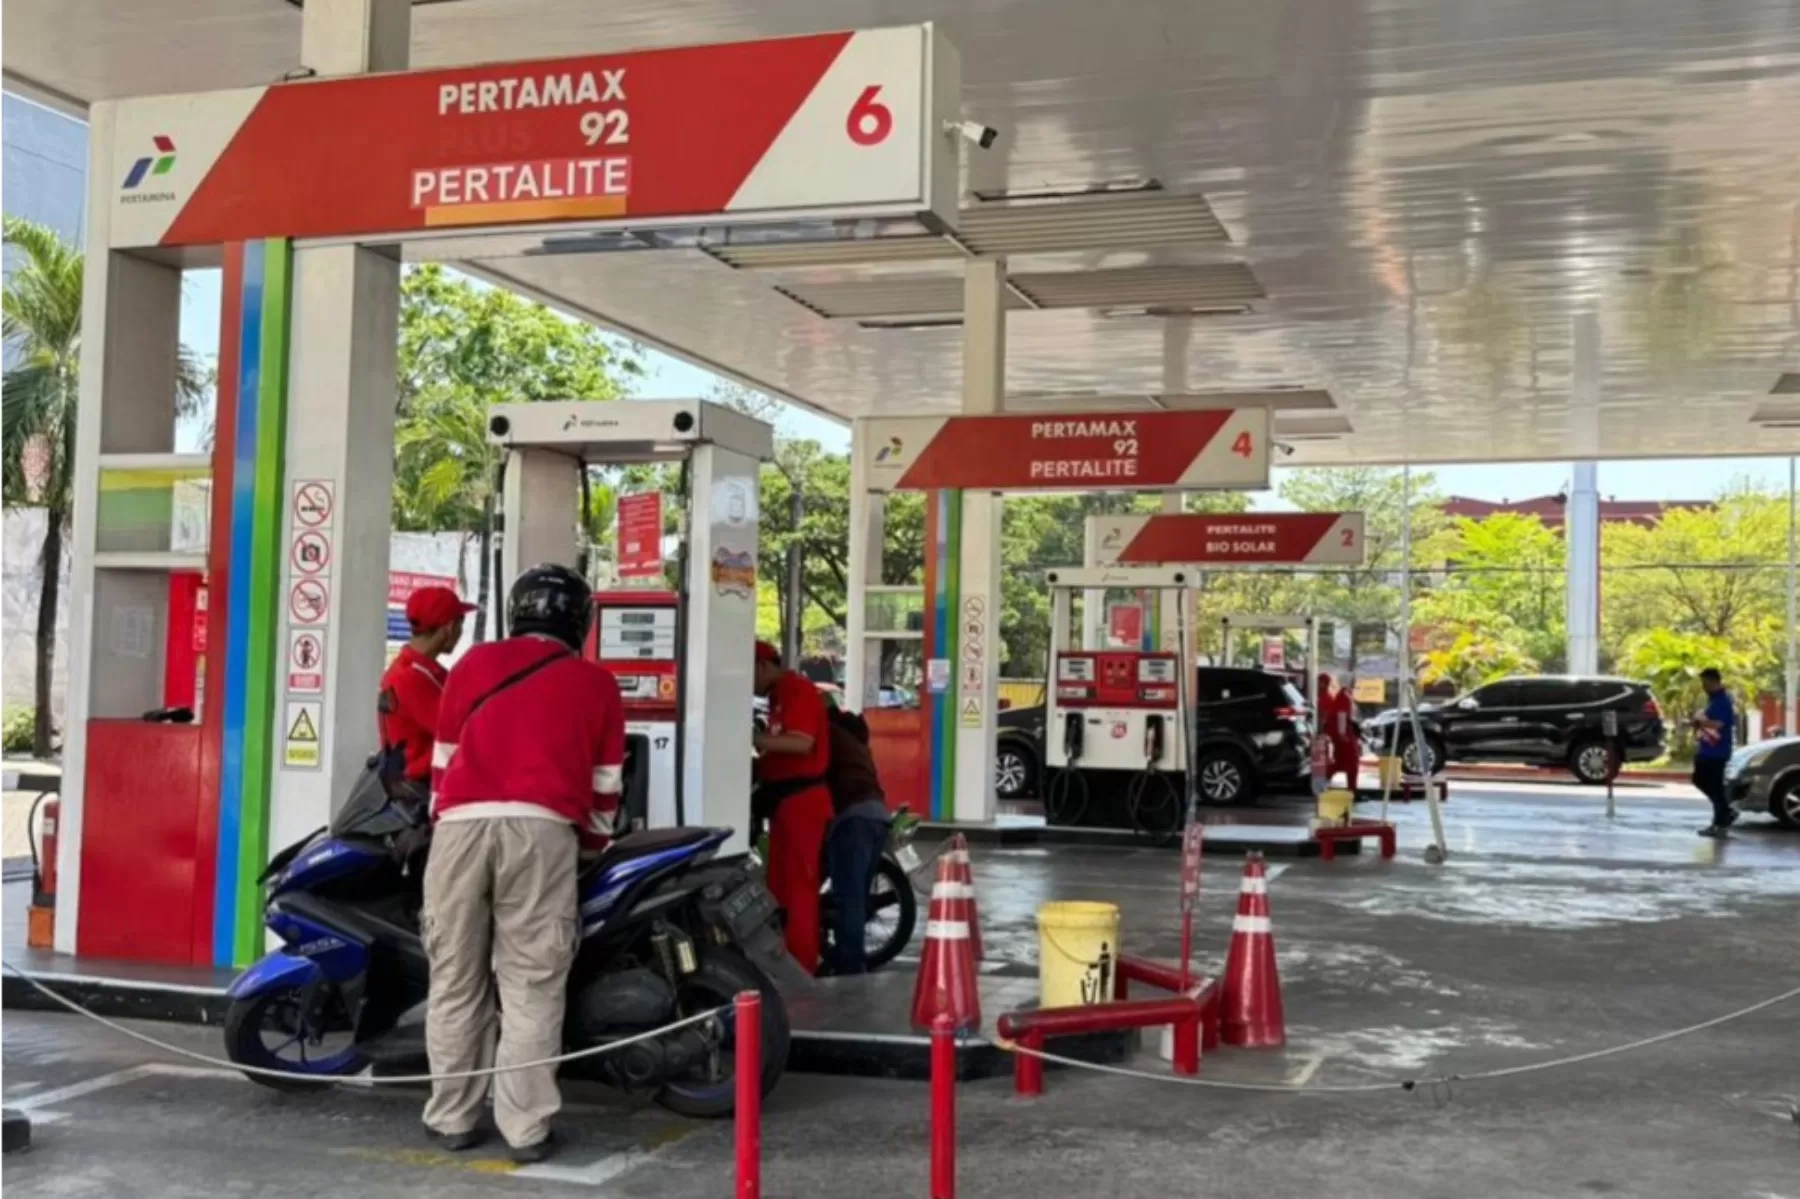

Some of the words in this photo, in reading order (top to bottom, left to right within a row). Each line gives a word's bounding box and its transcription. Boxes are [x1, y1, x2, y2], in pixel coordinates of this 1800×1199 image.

[438, 68, 626, 115] PERTAMAX
[846, 84, 892, 145] 6
[579, 108, 630, 146] 92
[413, 157, 628, 205] PERTALITE
[1032, 420, 1137, 438] PERTAMAX
[1113, 438, 1138, 456] 92
[1231, 430, 1253, 458] 4
[1030, 459, 1137, 478] PERTALITE
[1206, 524, 1277, 536] PERTALITE
[1341, 529, 1354, 547] 2
[1206, 541, 1230, 553] BIO
[1232, 541, 1276, 553] SOLAR
[654, 736, 669, 749] 17
